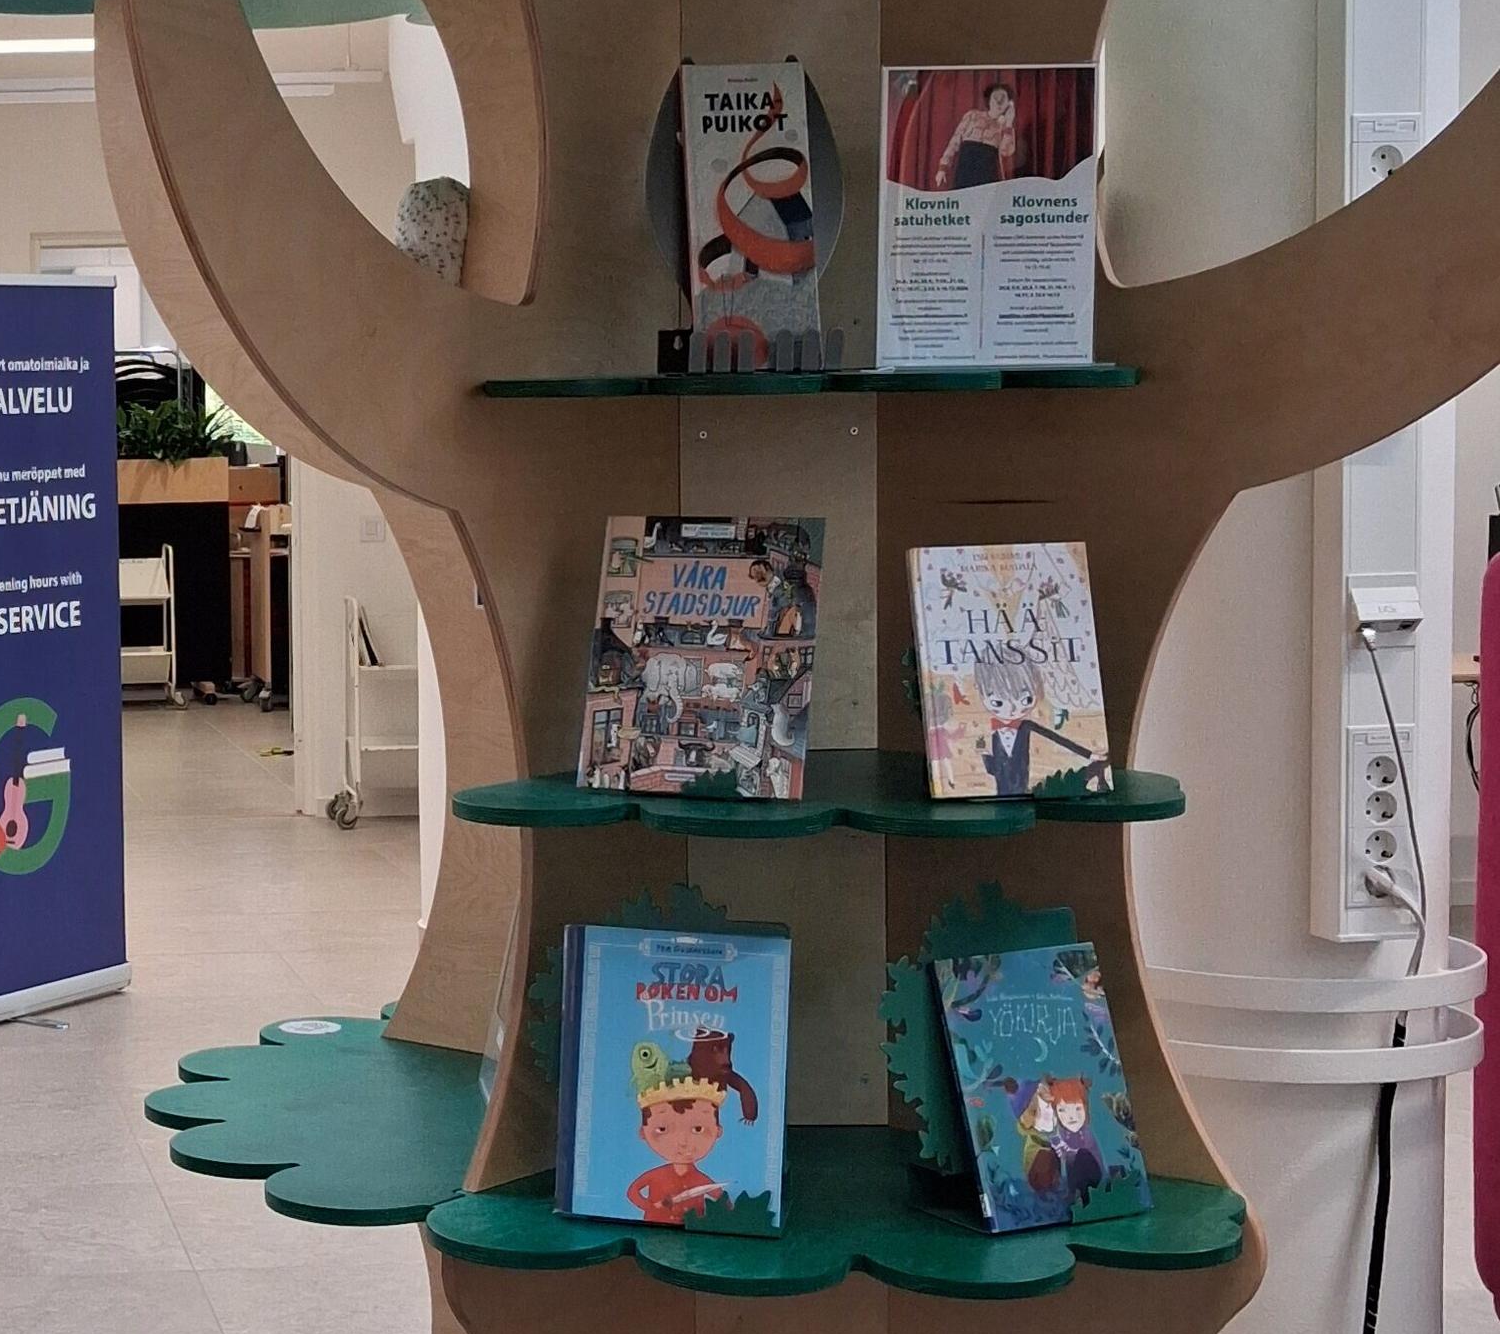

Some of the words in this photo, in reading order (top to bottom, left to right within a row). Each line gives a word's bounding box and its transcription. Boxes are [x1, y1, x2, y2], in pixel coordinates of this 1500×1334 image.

[702, 114, 788, 134] PUIKOT
[905, 198, 959, 210] Klovnin
[1012, 196, 1077, 208] Klovnens
[893, 214, 971, 226] satuhetket
[1000, 211, 1089, 226] sagostunder
[79, 357, 90, 373] ja
[64, 464, 86, 478] med
[29, 575, 58, 589] hours
[60, 571, 83, 586] with
[673, 560, 727, 590] VÅRA
[643, 591, 761, 617] STADSDJUR
[989, 1003, 1077, 1045] YÖKIRJA
